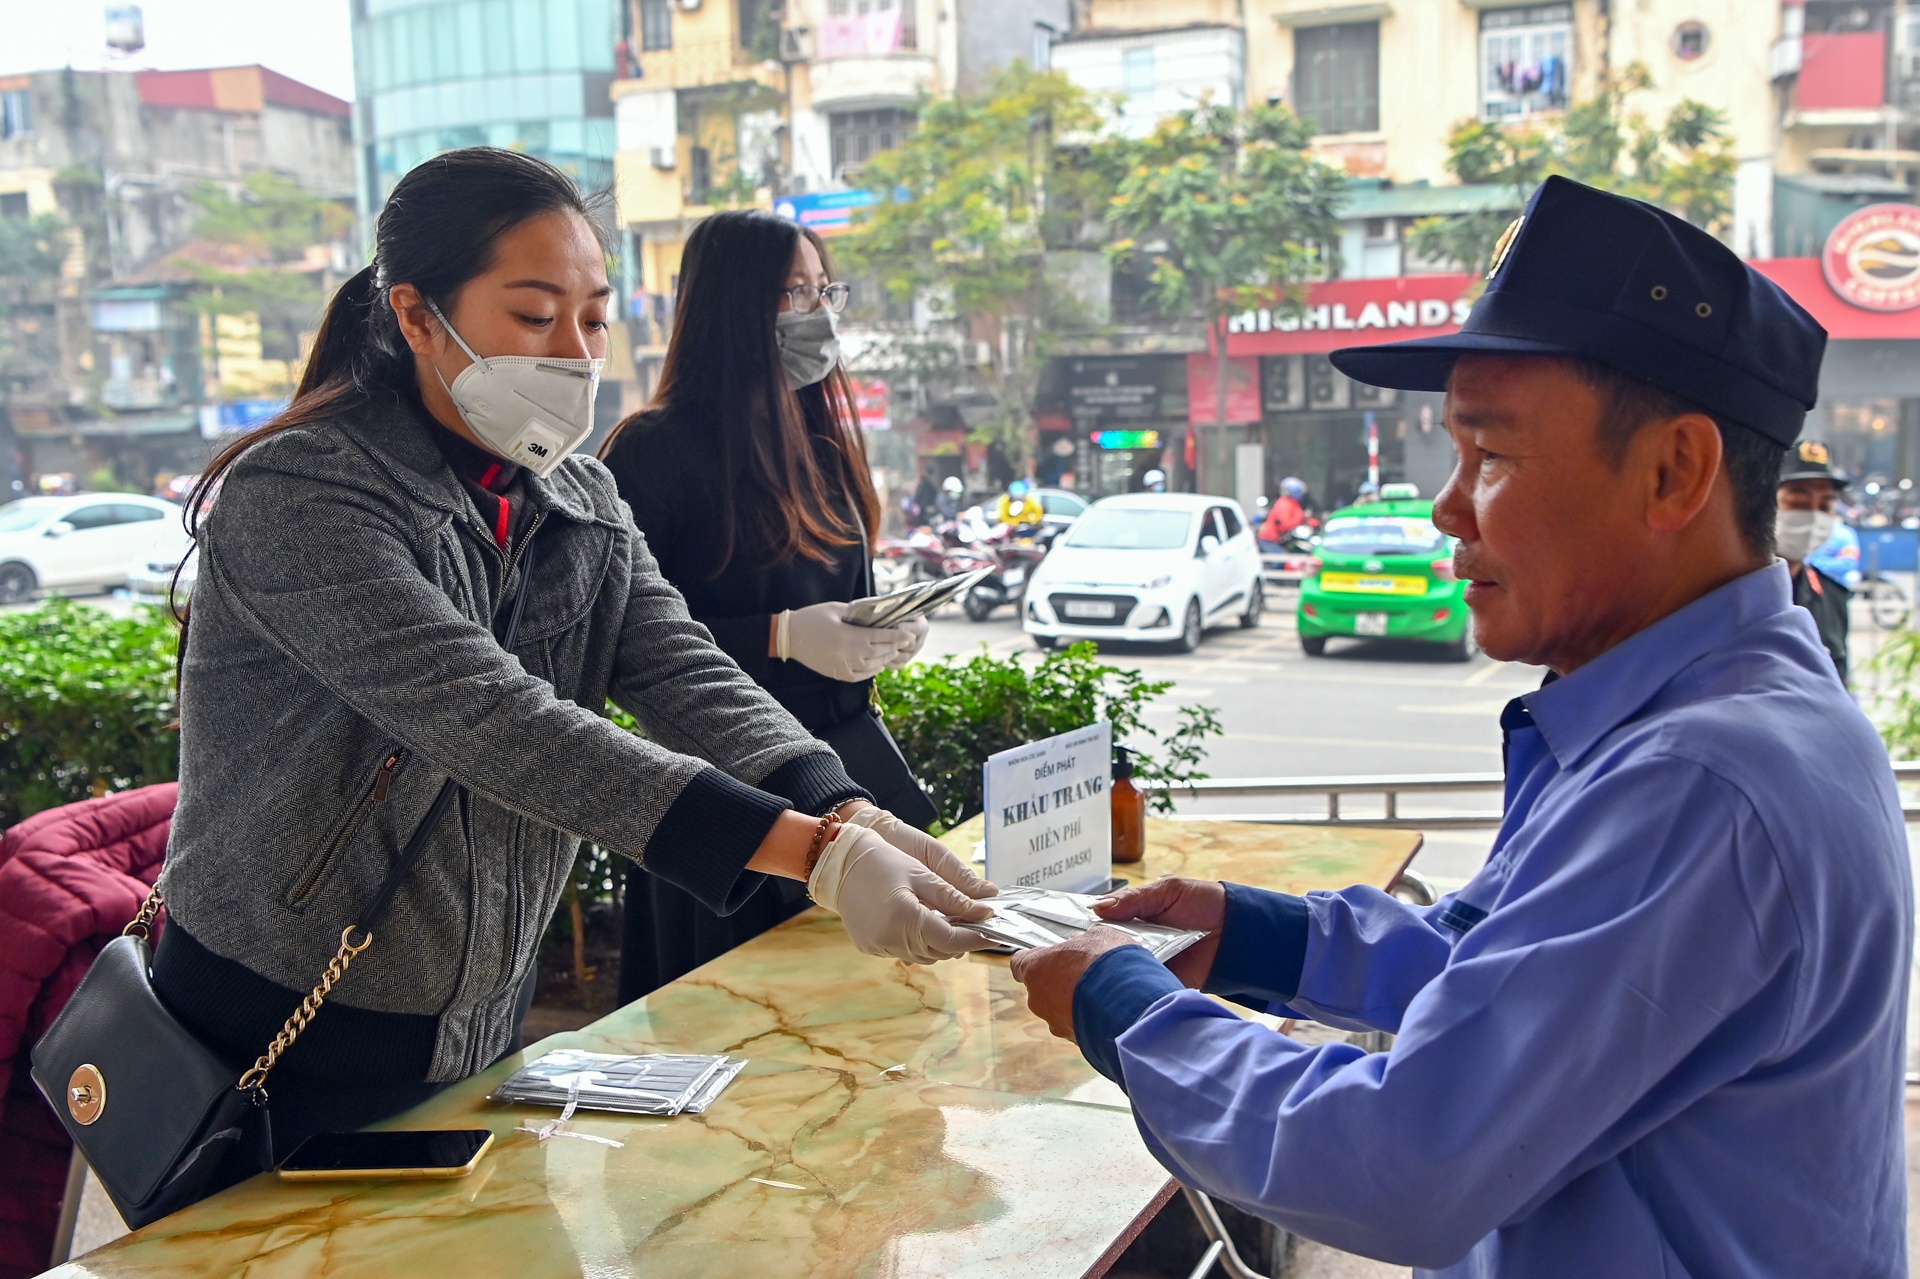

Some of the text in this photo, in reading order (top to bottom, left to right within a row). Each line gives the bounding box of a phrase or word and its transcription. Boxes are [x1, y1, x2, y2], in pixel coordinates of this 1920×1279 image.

[1228, 299, 1472, 334] HIGHLANDS
[527, 442, 549, 458] 3M
[1056, 756, 1076, 773] PHÁT
[1052, 776, 1102, 809] TRANG
[1063, 816, 1082, 841] PHÍ
[1016, 848, 1092, 887] (FREE FACE MASK)
